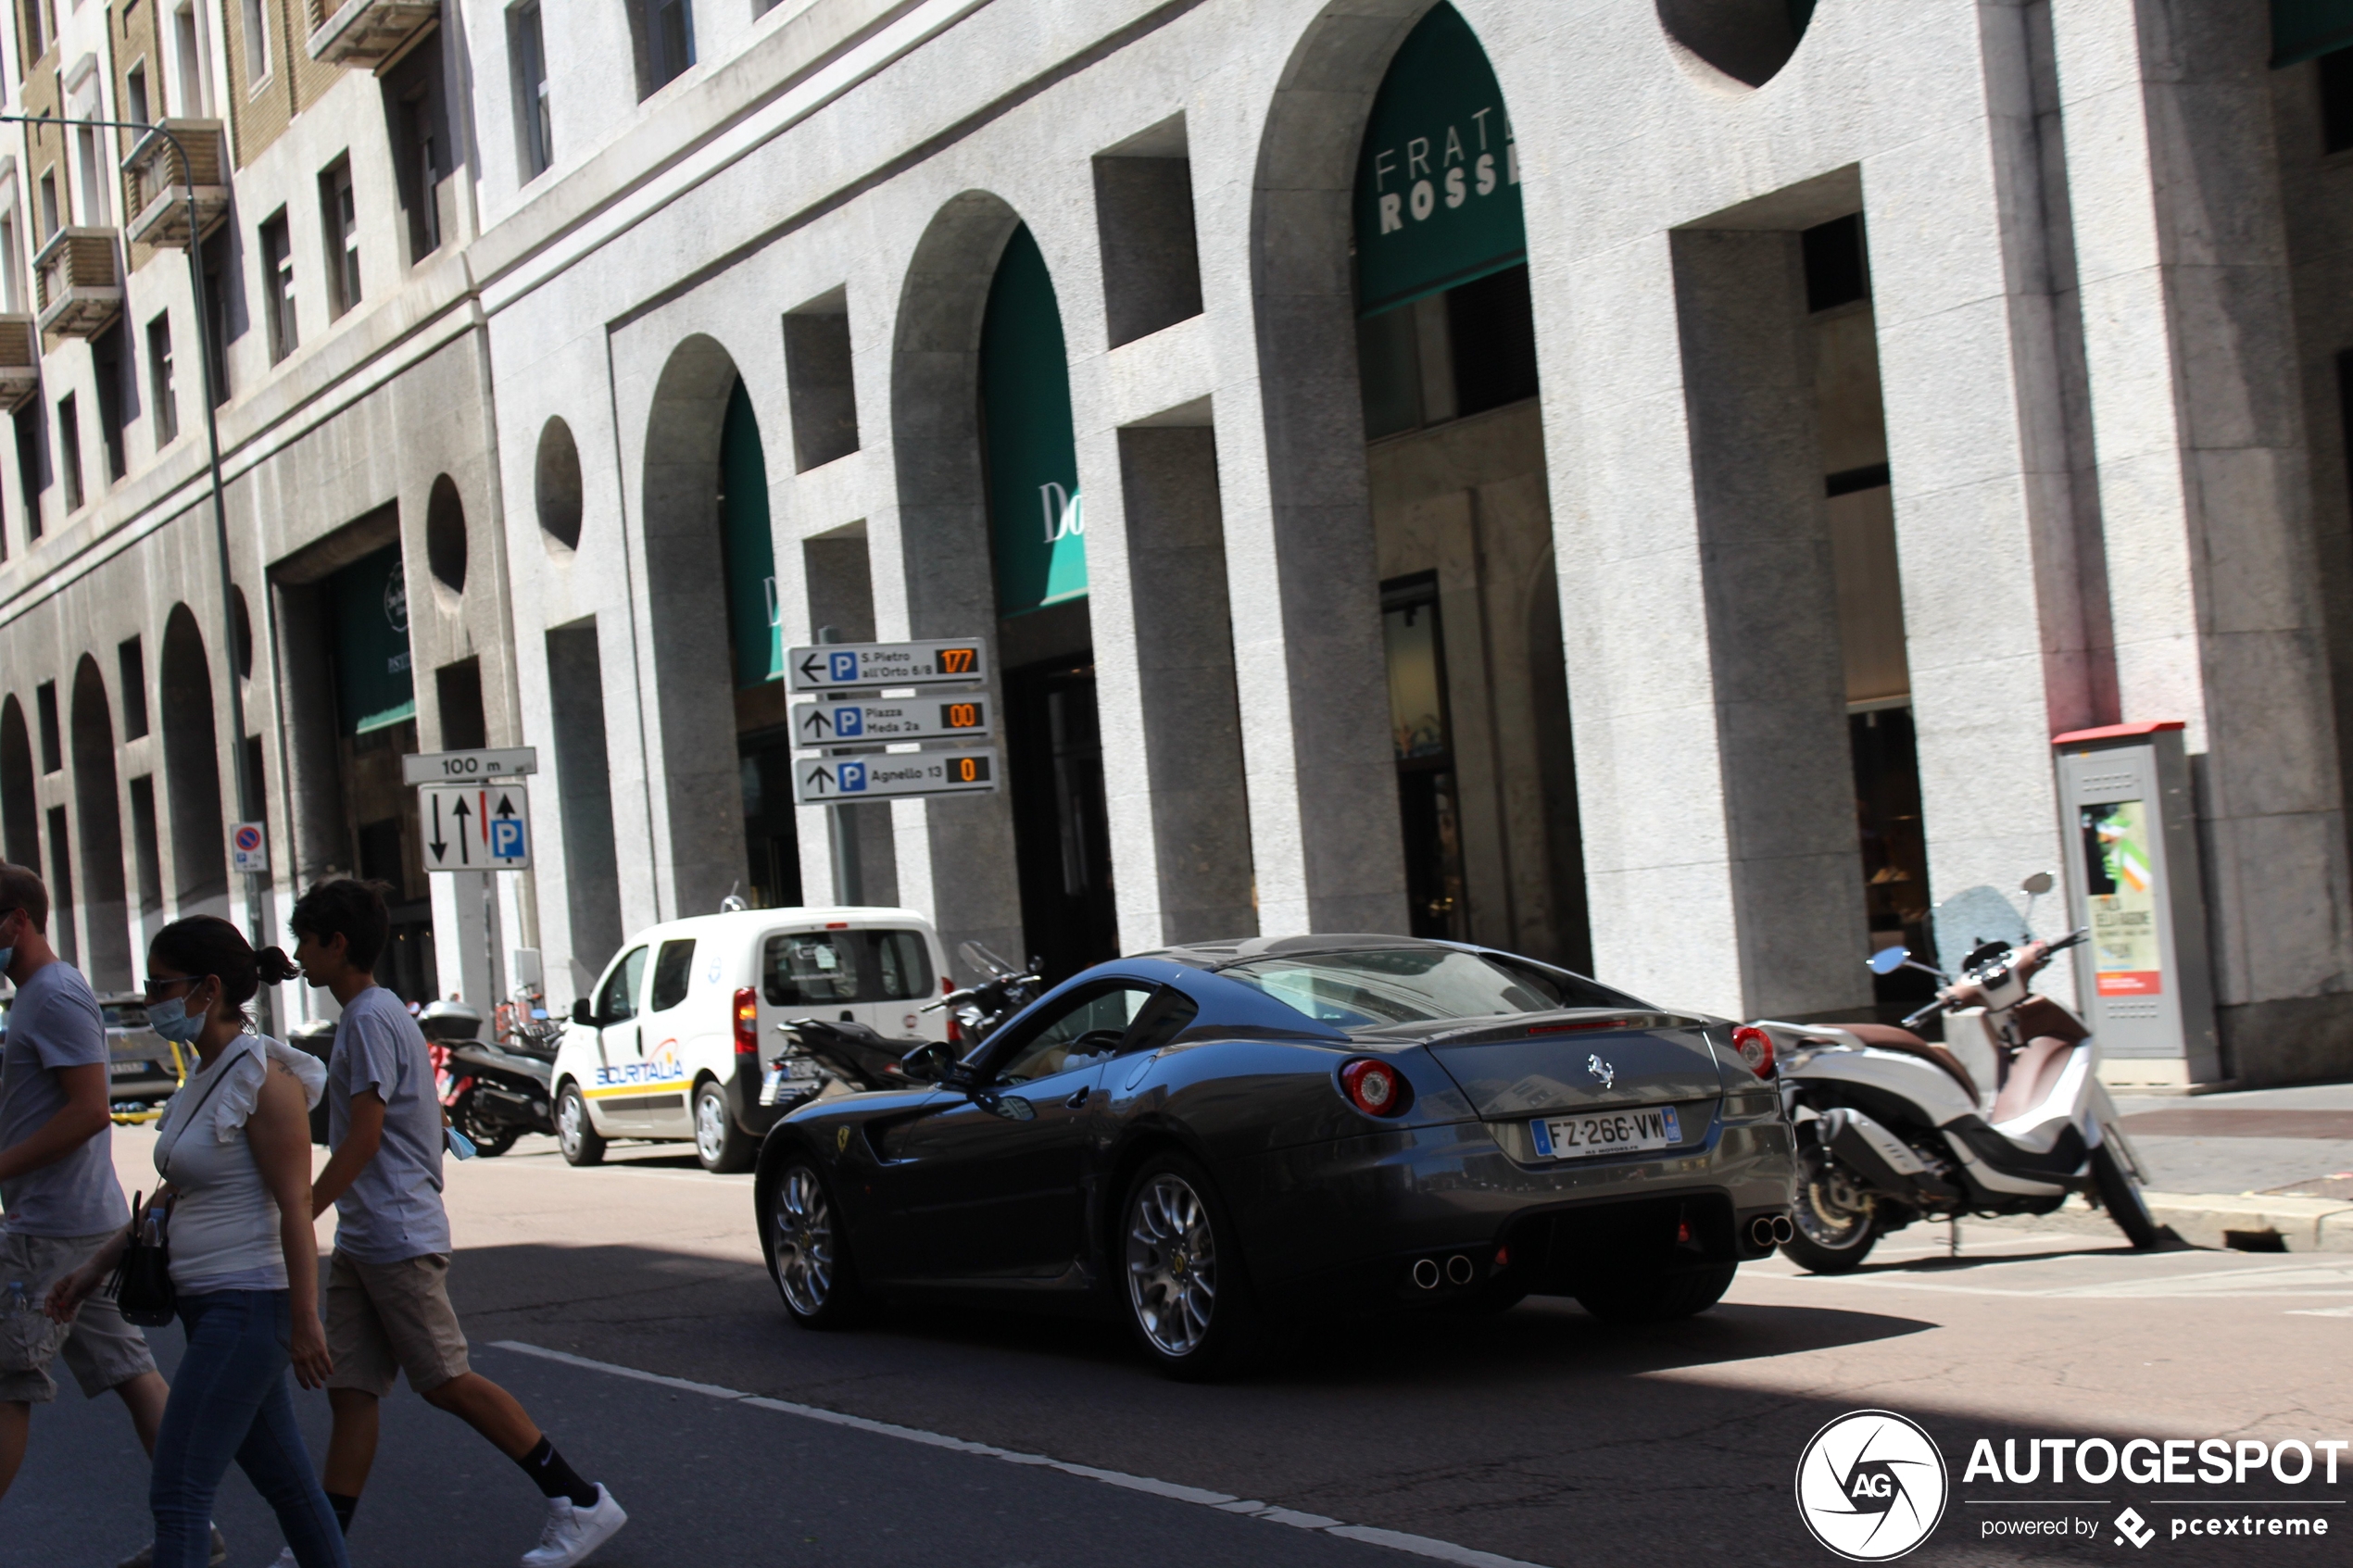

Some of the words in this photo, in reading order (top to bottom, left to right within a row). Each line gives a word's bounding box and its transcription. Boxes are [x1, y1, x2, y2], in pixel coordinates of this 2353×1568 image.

[834, 656, 852, 678] P
[862, 666, 909, 678] all'Orto
[911, 664, 933, 676] 6/8
[941, 648, 974, 674] 177
[839, 711, 857, 733] P
[865, 707, 903, 718] Piazza
[949, 703, 976, 728] 00
[866, 721, 900, 734] Meda
[903, 721, 920, 732] 2a
[442, 758, 478, 774] 100
[486, 760, 501, 771] m
[843, 766, 861, 788] P
[871, 768, 923, 784] Agnello
[927, 766, 943, 779] 13
[960, 757, 977, 782] 0
[496, 823, 518, 855] P
